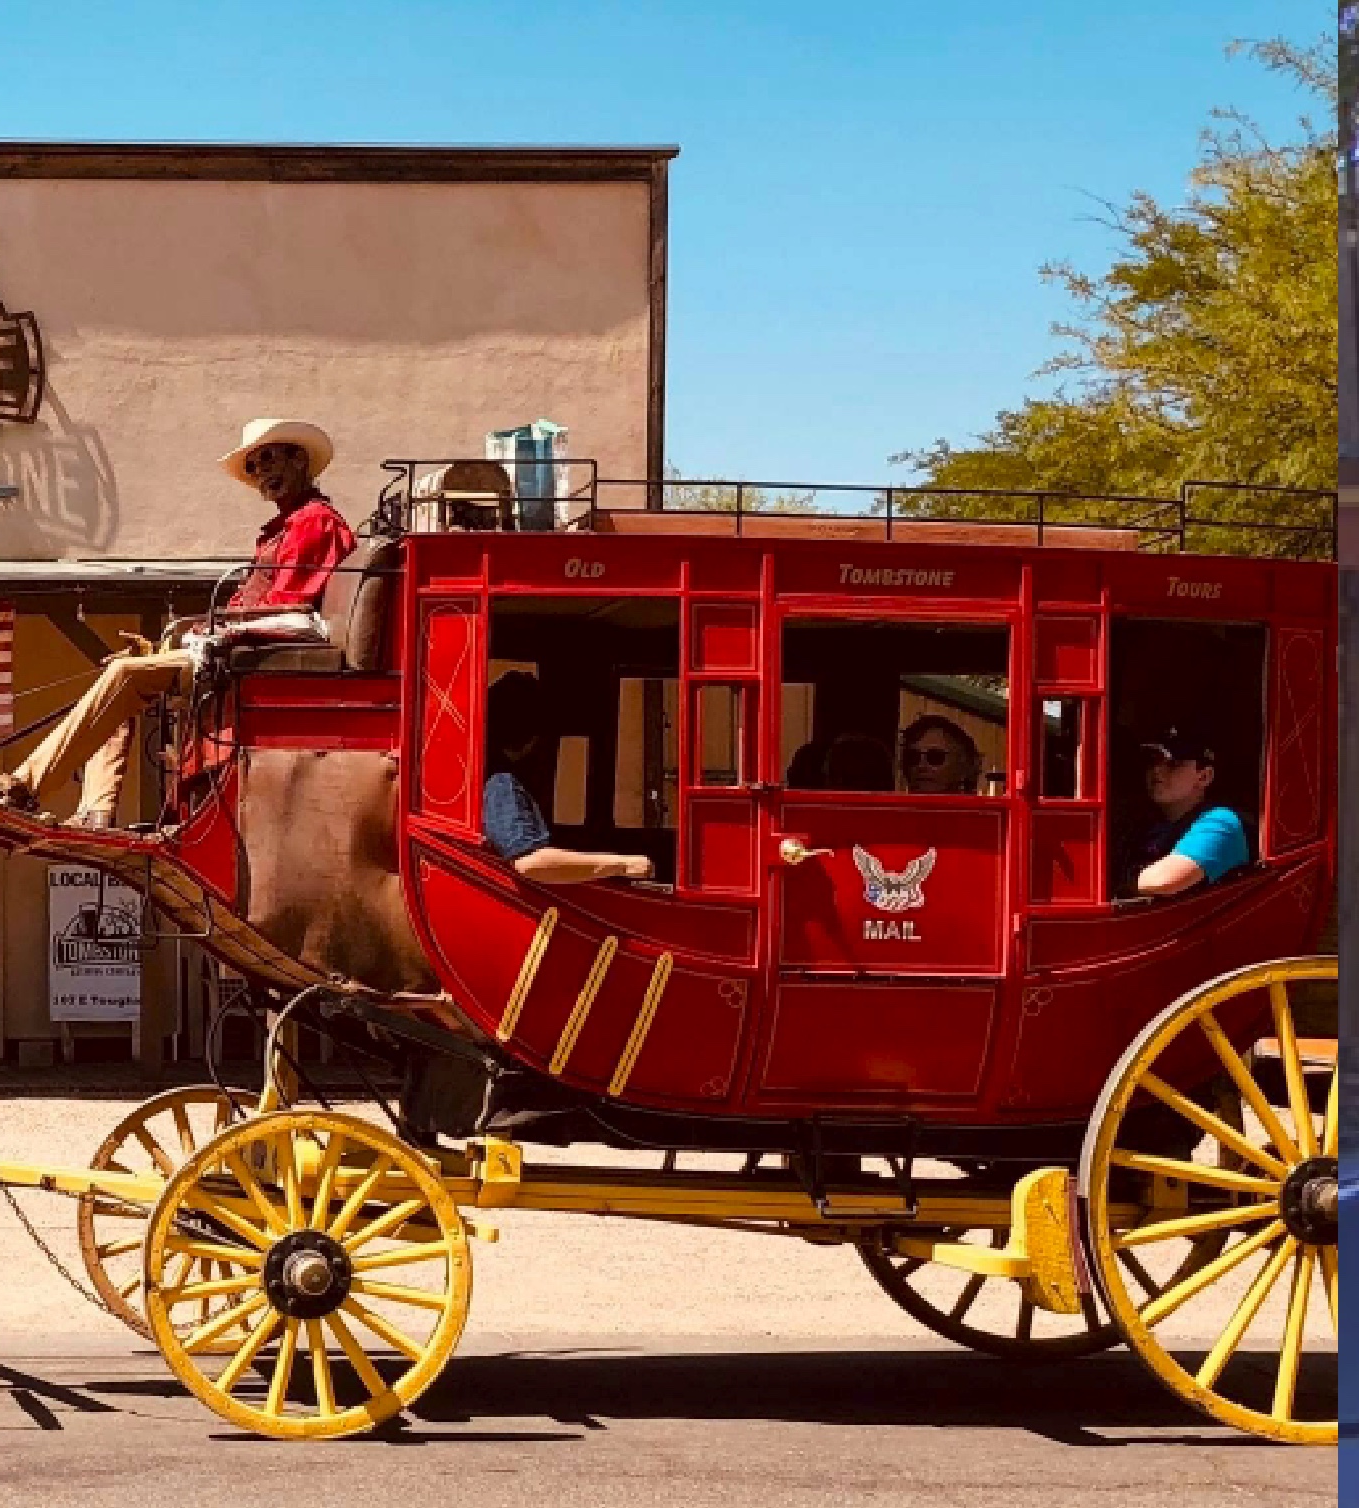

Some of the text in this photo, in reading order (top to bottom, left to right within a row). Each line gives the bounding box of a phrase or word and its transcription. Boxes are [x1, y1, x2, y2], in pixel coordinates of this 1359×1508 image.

[49, 872, 99, 887] LOCAL
[863, 919, 922, 942] MAIL
[61, 941, 140, 961] TOMBSTON
